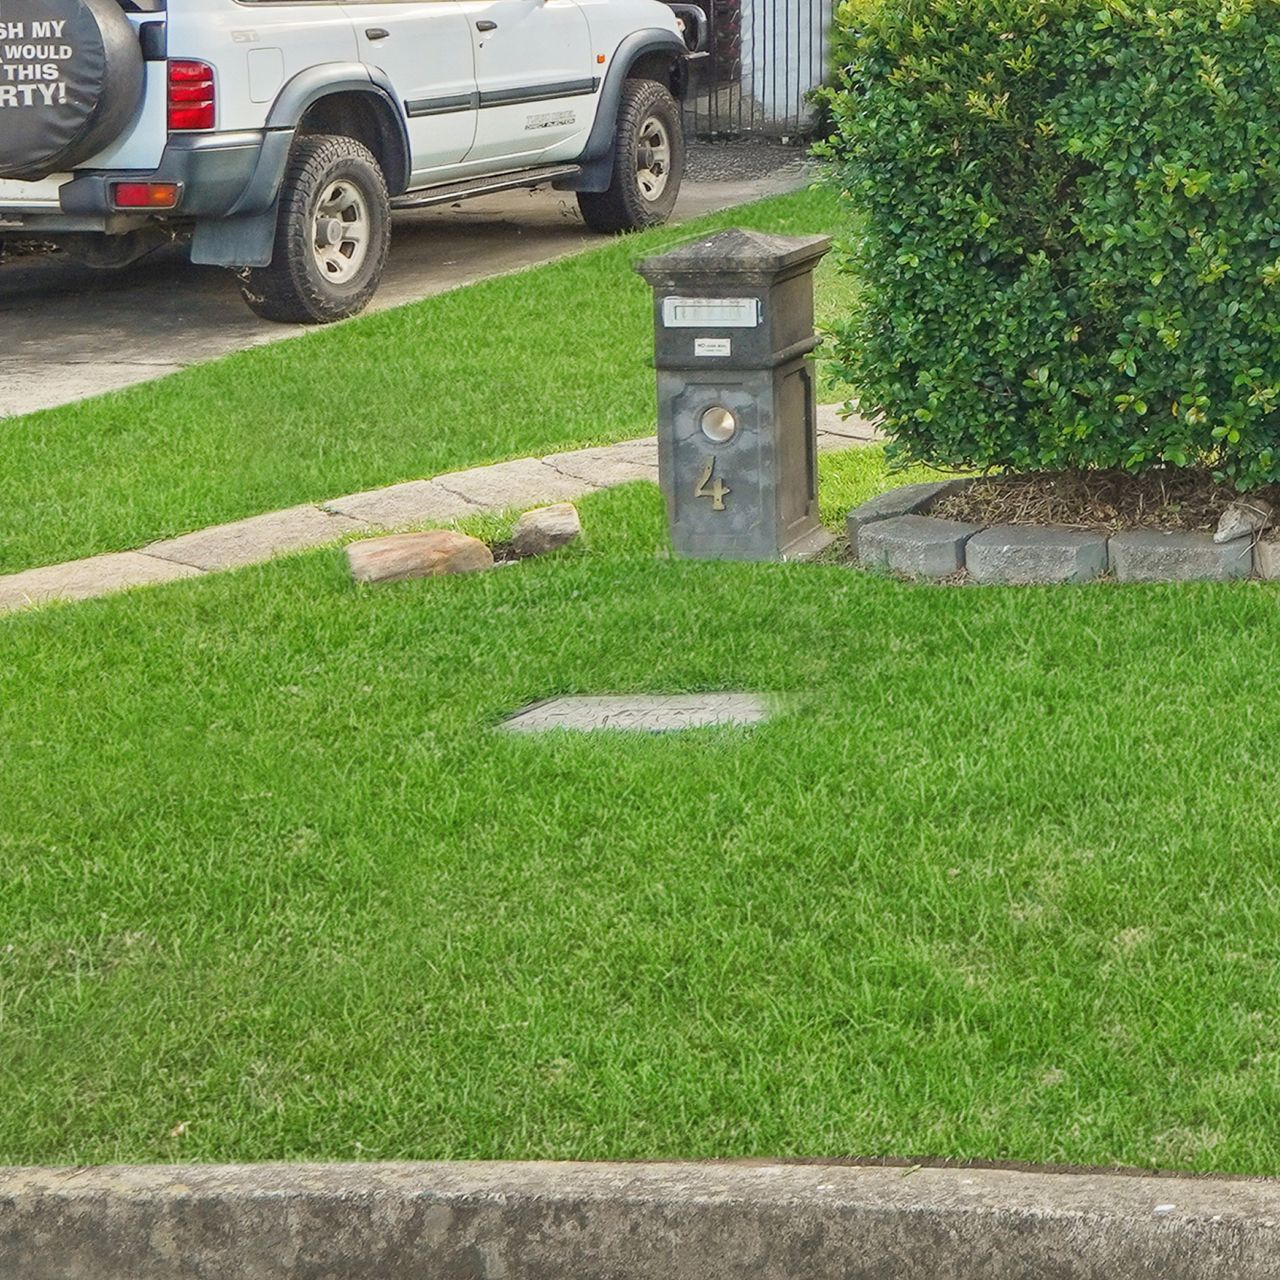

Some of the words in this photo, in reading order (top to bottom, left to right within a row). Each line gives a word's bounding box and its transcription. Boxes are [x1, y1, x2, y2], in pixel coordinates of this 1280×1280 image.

[32, 20, 66, 38] MY
[4, 44, 73, 60] WOULD
[3, 63, 60, 81] THIS
[694, 455, 732, 512] 4
